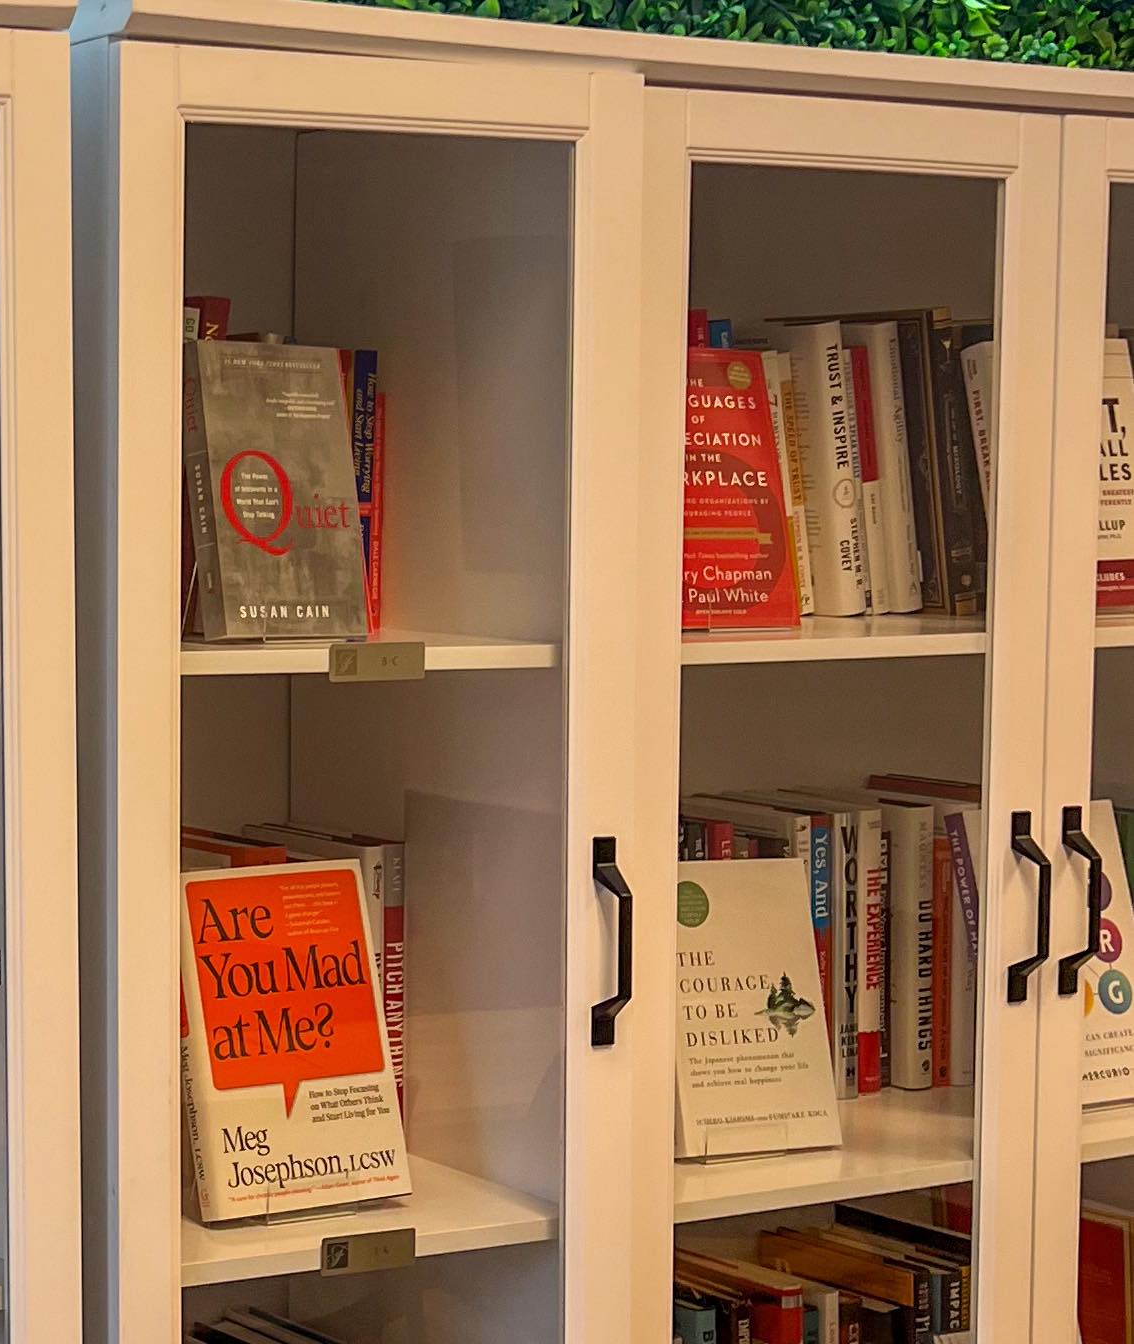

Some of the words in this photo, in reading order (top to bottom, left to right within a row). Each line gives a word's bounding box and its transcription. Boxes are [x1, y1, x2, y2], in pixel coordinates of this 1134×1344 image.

[826, 343, 842, 389] TRUST
[831, 396, 840, 406] &
[832, 411, 850, 470] INSPIRE
[220, 449, 350, 556] Quiet
[839, 539, 852, 573] COVEY
[703, 566, 772, 583] Chapman
[688, 587, 720, 603] Paul
[725, 587, 769, 603] White
[240, 605, 288, 618] SUSAN
[296, 605, 330, 618] CAIN
[198, 898, 274, 945] Are
[201, 953, 284, 1001] You
[283, 940, 367, 991] Mad
[676, 951, 715, 967] THE
[679, 975, 770, 994] COURAGE
[684, 1004, 708, 1020] TO
[715, 1002, 738, 1018] BE
[213, 1017, 250, 1061] at
[254, 1003, 334, 1053] Me?
[686, 1028, 778, 1047] DISLIKED
[222, 1126, 268, 1155] Meg
[228, 1150, 348, 1189] Josephson,
[349, 1149, 396, 1174] LCSW
